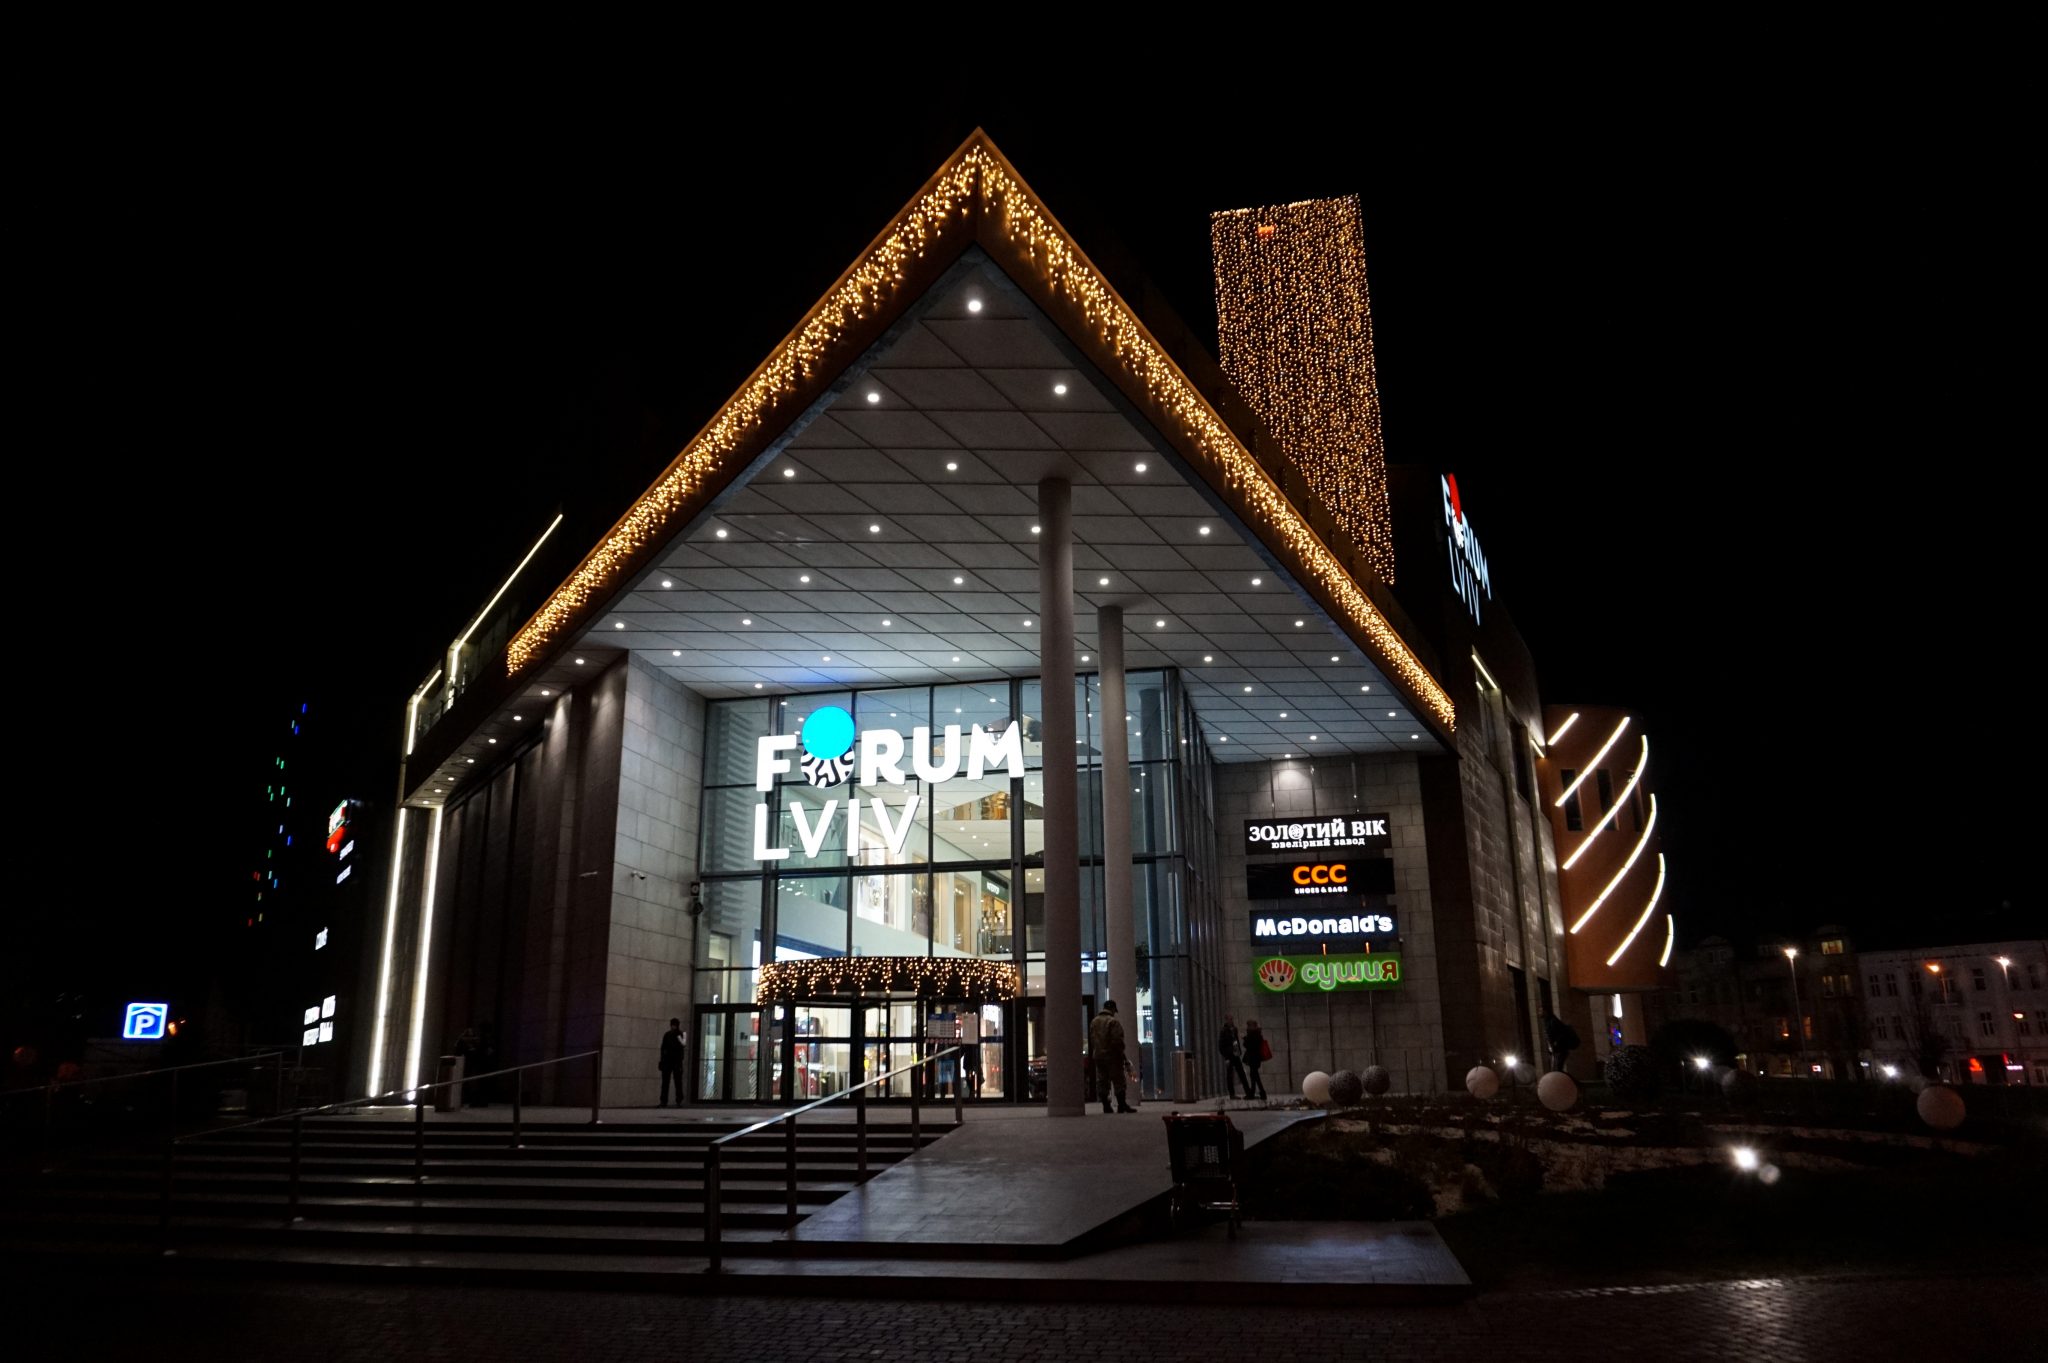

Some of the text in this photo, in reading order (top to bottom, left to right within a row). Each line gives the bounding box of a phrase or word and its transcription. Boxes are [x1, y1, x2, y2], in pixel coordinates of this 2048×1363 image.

[1448, 536, 1480, 626] LVIV
[756, 706, 1025, 792] FORUM
[753, 795, 922, 861] LVIV
[1249, 819, 1387, 842] ЗОЛОТИЙ ВІК
[1271, 837, 1366, 850] ювелірний завод
[1292, 864, 1347, 885] CCC
[1255, 914, 1393, 937] McDonald's
[134, 1014, 155, 1037] P
